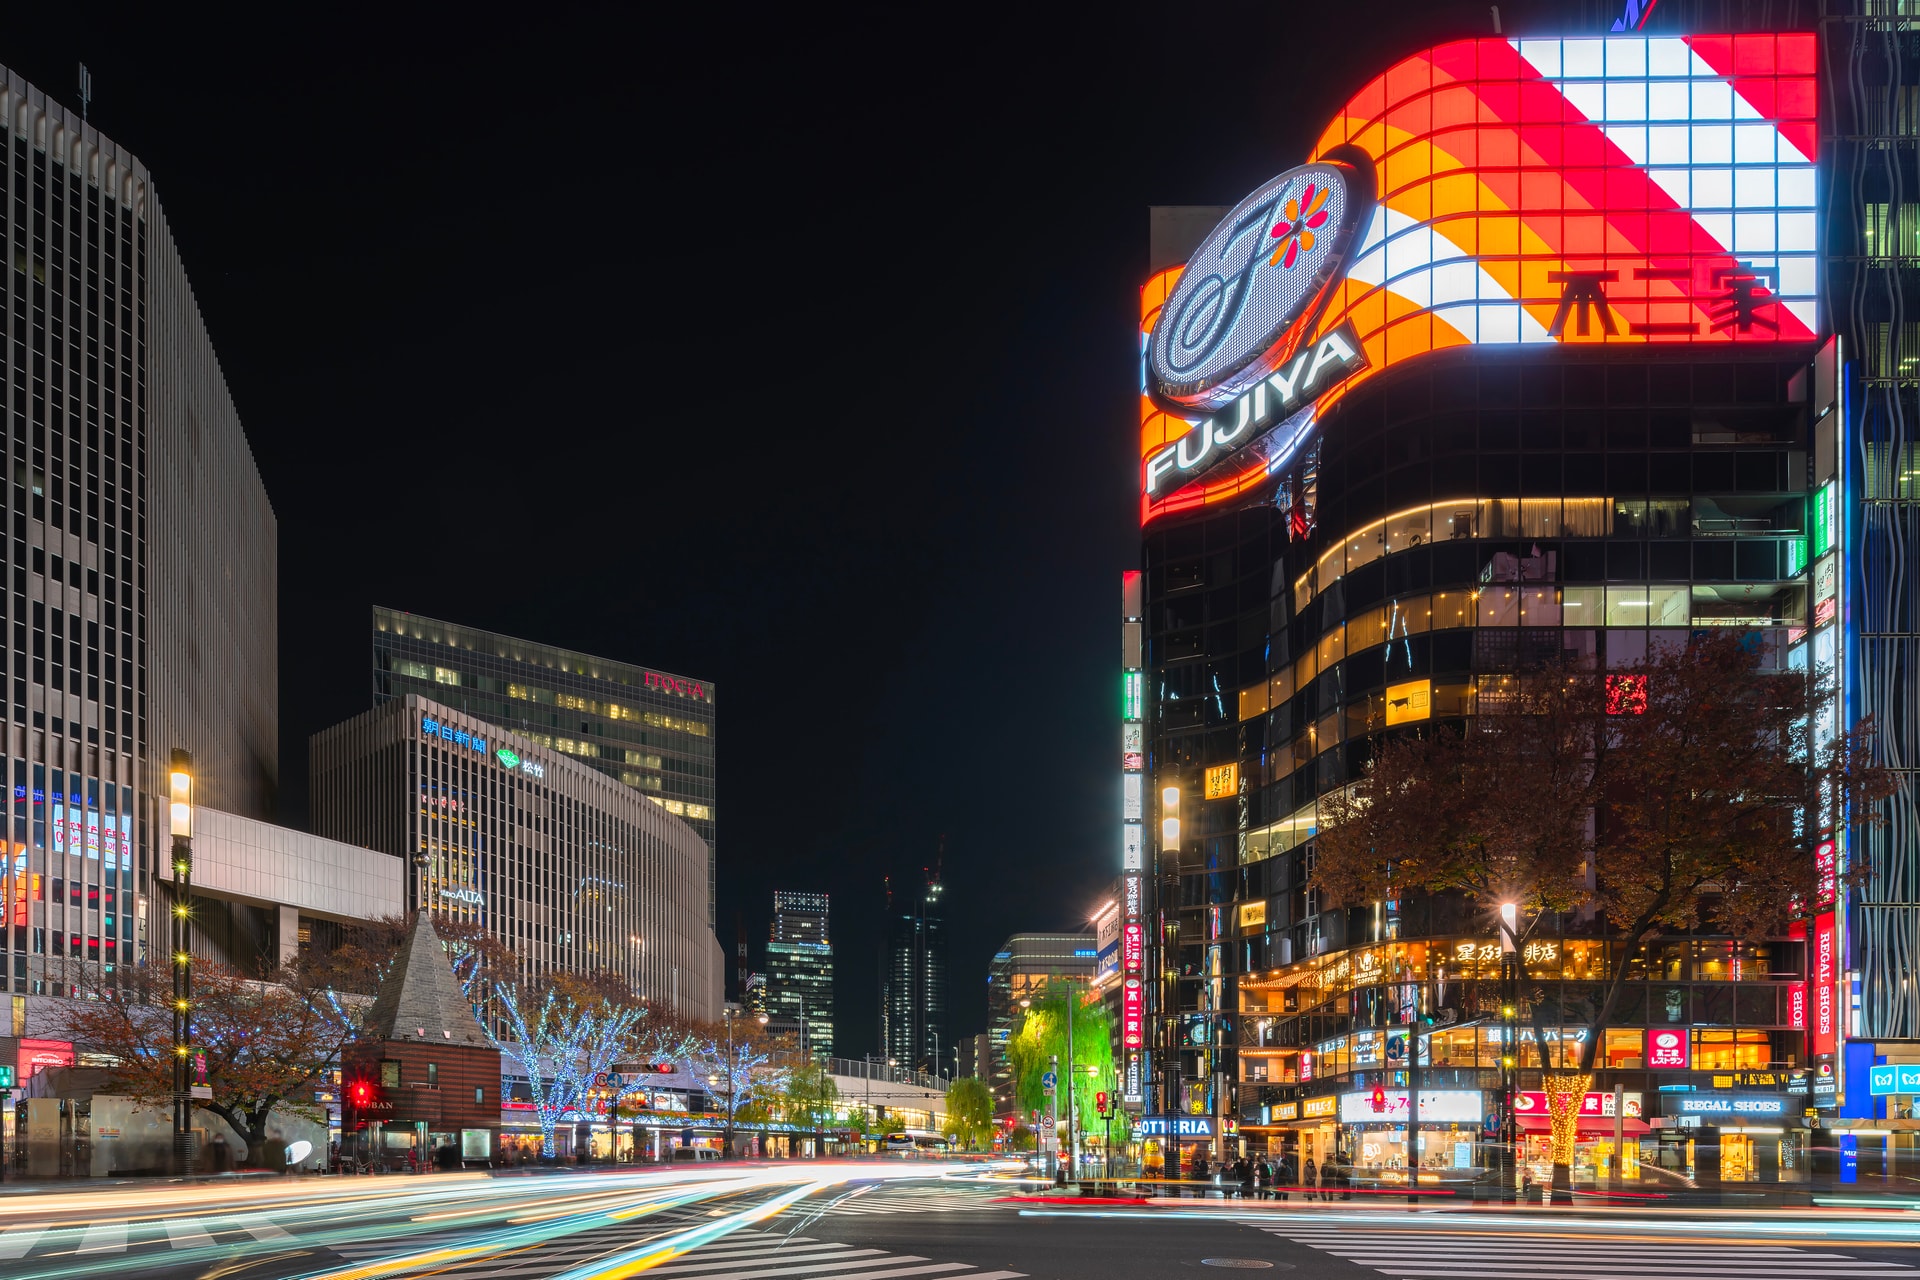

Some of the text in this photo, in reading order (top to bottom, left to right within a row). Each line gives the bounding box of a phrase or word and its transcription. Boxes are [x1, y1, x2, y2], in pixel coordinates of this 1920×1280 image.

[1547, 261, 1780, 336] 不二家
[1146, 332, 1356, 494] FUJIYA
[422, 718, 487, 755] 朝日新聞
[522, 760, 544, 778] 松竹
[1357, 976, 1378, 984] COFFEE
[1820, 931, 1830, 1034] REGAL SHOES
[1128, 991, 1138, 1031] 不二家
[1352, 1042, 1381, 1053] ハンバーグ
[1655, 1049, 1679, 1057] 不二家
[1651, 1057, 1684, 1065] レストラン
[1683, 1101, 1781, 1111] REGAL SHOES
